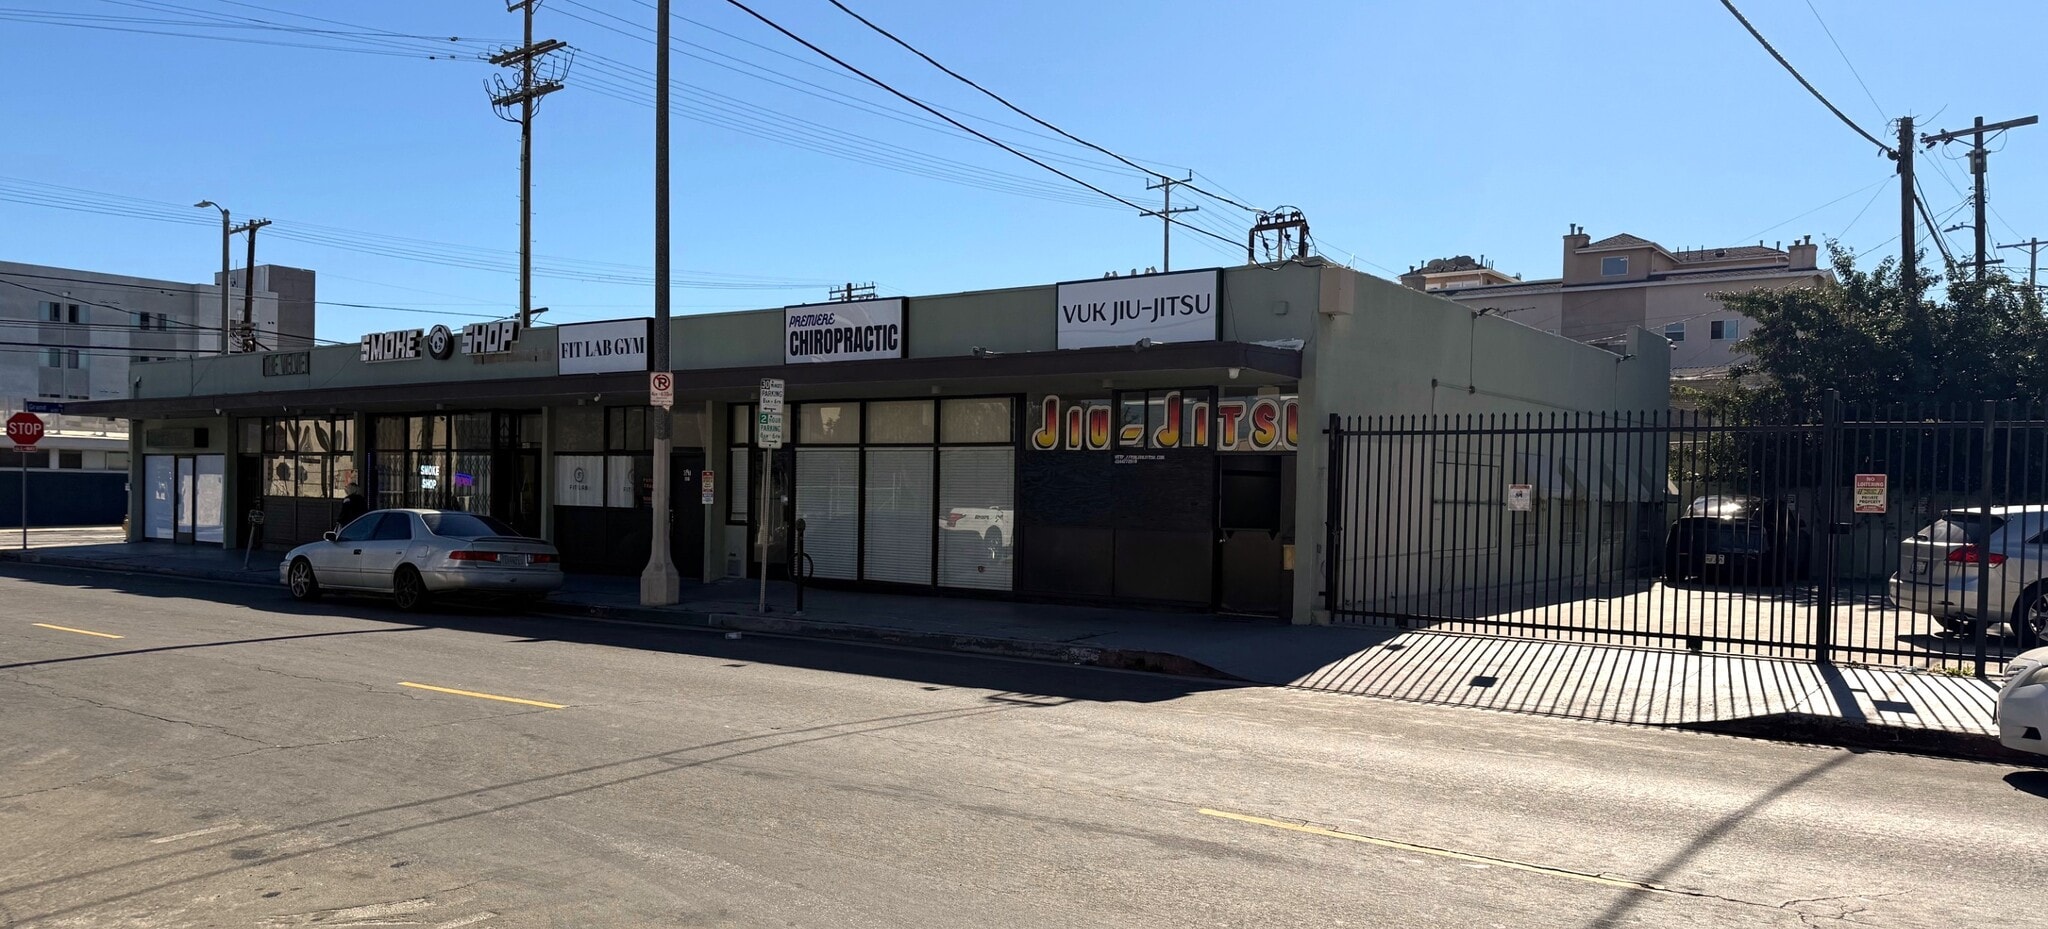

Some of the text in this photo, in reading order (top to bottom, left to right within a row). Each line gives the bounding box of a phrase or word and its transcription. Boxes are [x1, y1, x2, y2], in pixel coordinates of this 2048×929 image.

[1062, 293, 1211, 326] VUK JIU-JITSU
[360, 321, 516, 361] SMOKE SHOP
[789, 313, 899, 357] PREMIERE CHIROPRACTIC
[561, 336, 645, 359] FIT LAB GYM
[761, 390, 783, 398] PARKING
[761, 414, 767, 422] 2
[8, 421, 42, 435] STOP
[760, 424, 781, 432] PARKING
[420, 465, 440, 476] SMOKE
[421, 478, 437, 489] SHOP
